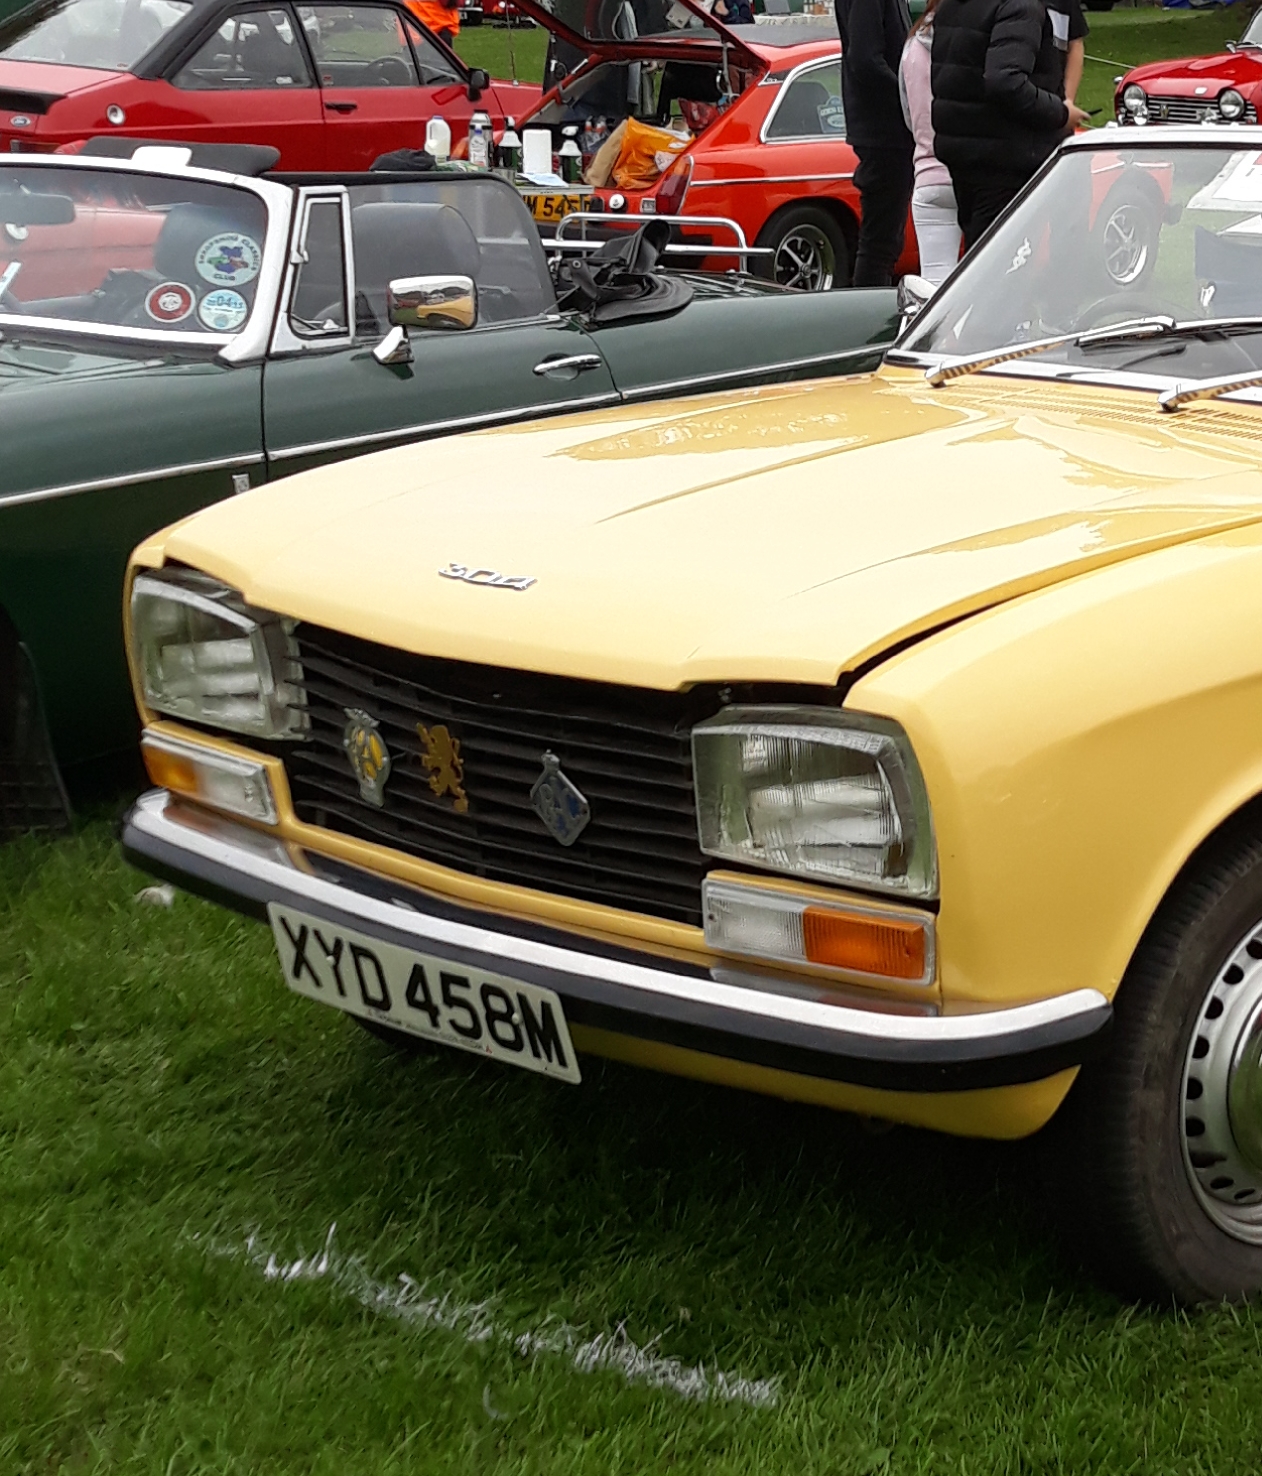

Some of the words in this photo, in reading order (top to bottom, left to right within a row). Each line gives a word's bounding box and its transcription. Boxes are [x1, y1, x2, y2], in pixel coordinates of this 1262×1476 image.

[438, 562, 538, 591] 304
[279, 914, 392, 1012] XYD
[405, 962, 570, 1069] 458M
